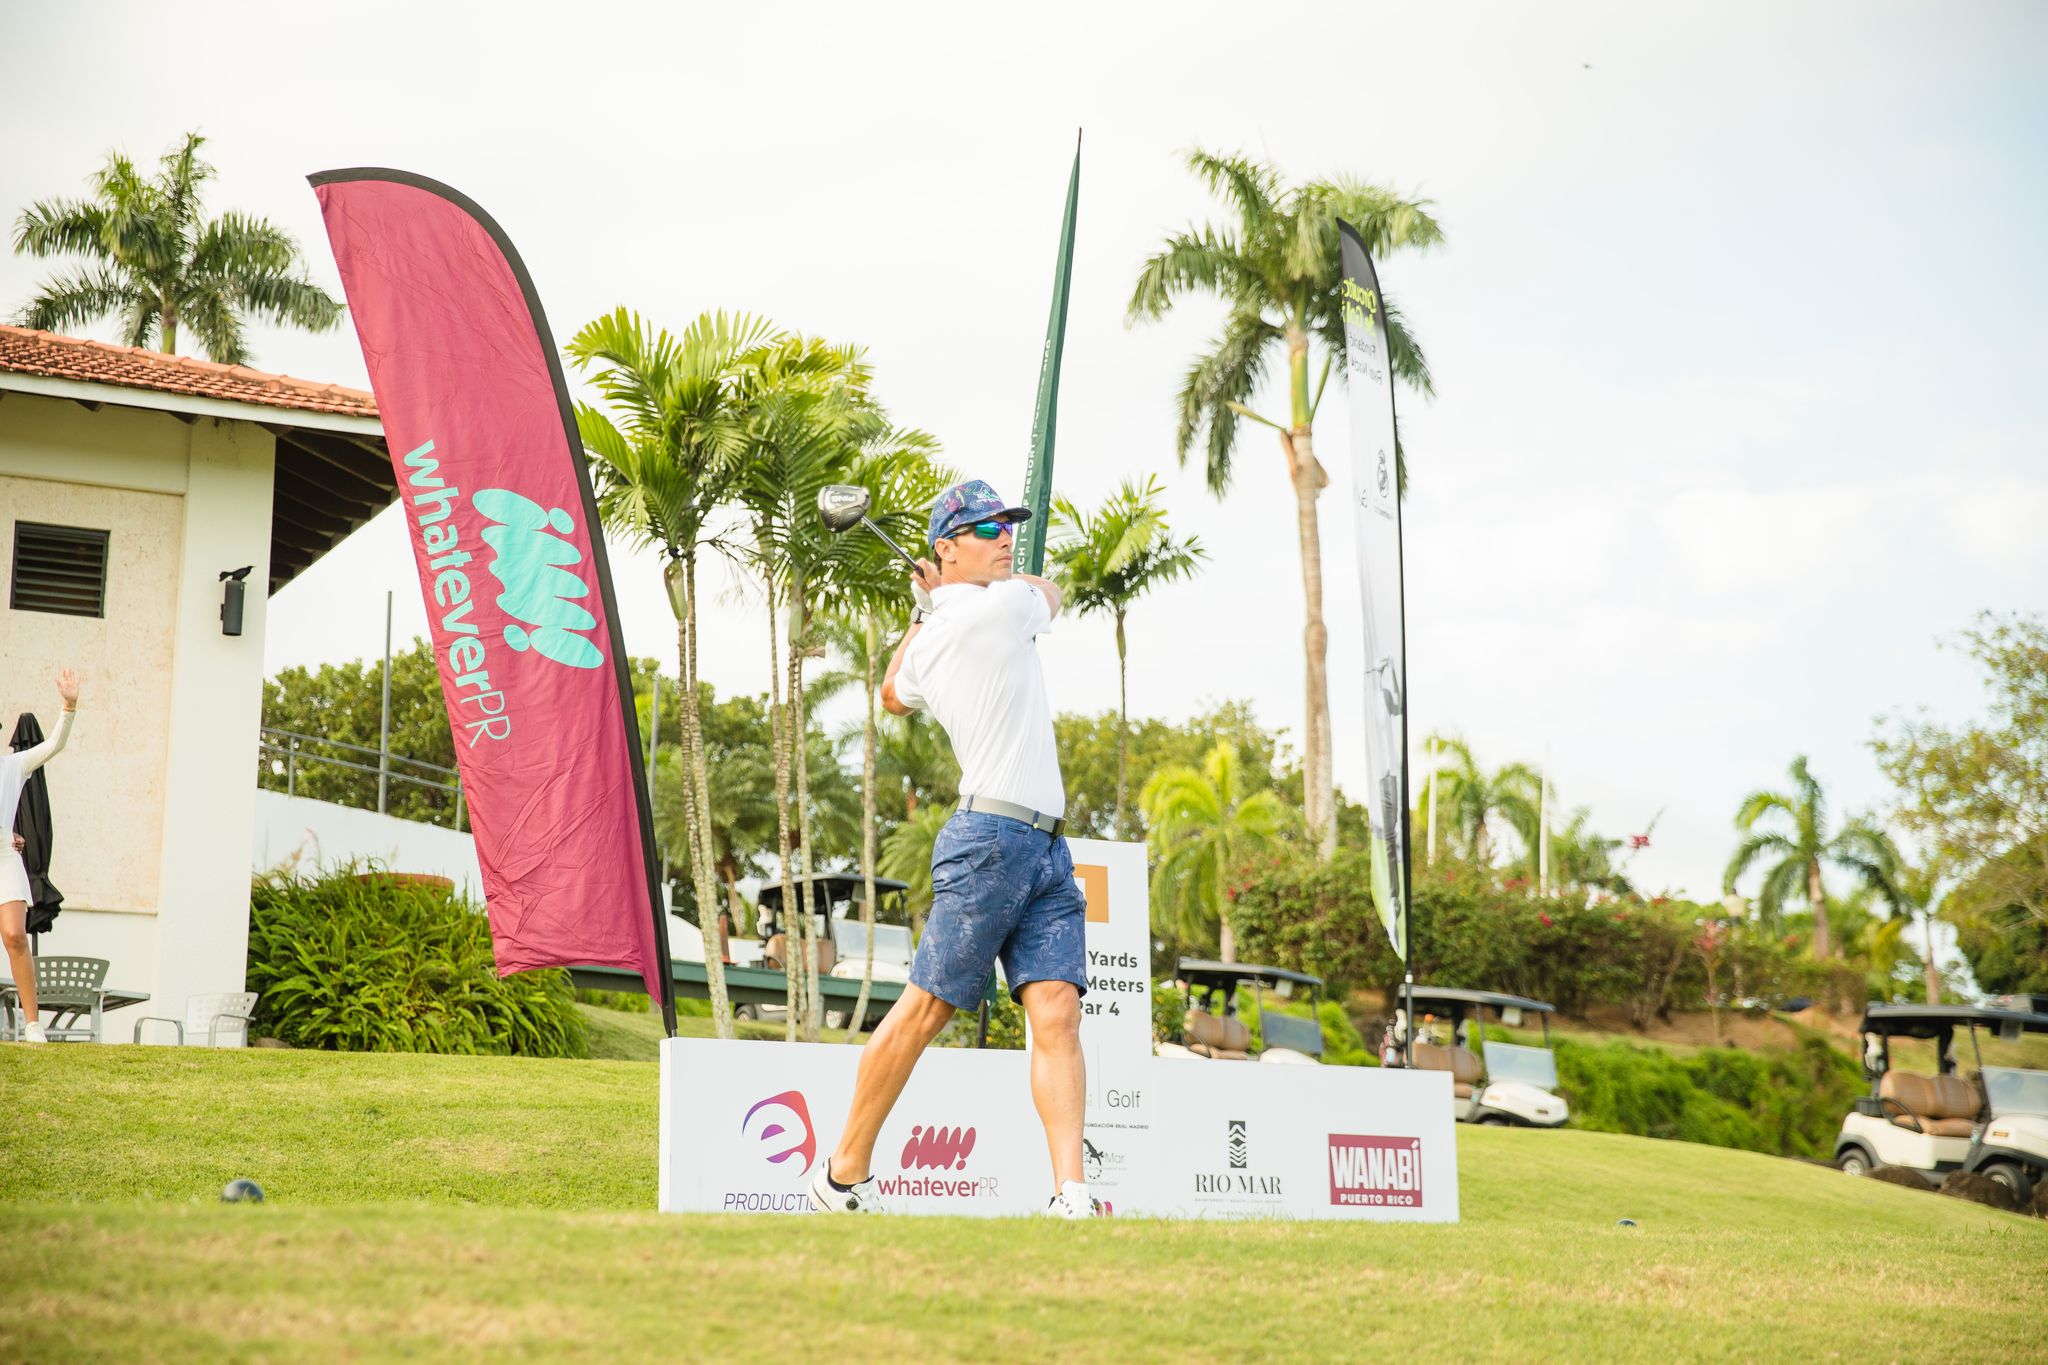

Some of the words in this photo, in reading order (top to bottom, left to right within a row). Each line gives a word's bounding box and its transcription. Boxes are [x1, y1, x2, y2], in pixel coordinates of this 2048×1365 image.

[1016, 546, 1026, 574] ACH
[403, 439, 511, 748] whateverPR
[1088, 951, 1138, 968] Yards
[1085, 976, 1144, 993] Meters
[1109, 1002, 1120, 1016] 4
[1107, 1089, 1141, 1109] Golf
[1104, 1152, 1125, 1165] Mar
[877, 1175, 999, 1198] whateverPR
[1195, 1174, 1231, 1193] RIO
[1237, 1175, 1283, 1195] MAR
[1340, 1193, 1384, 1205] PUERTO
[1386, 1194, 1414, 1206] RICO
